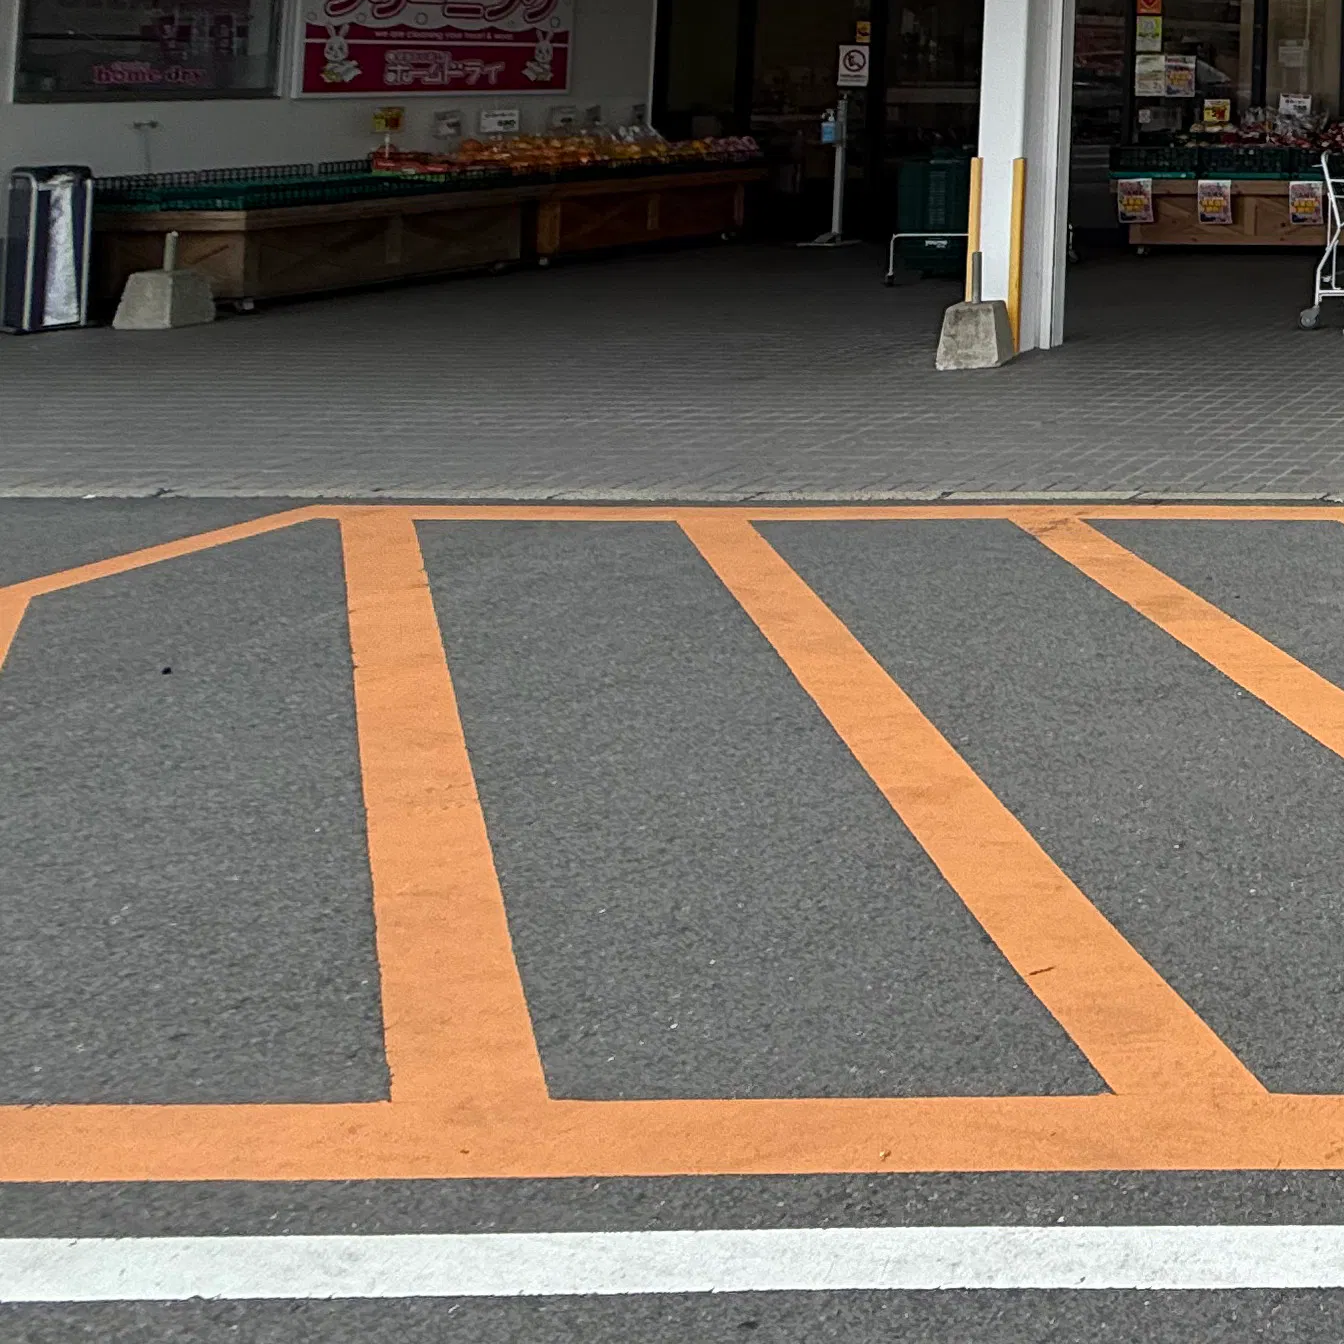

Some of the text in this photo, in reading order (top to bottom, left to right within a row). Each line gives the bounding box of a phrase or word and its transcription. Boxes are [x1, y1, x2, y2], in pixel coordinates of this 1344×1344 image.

[383, 51, 506, 86] ホームドライ
